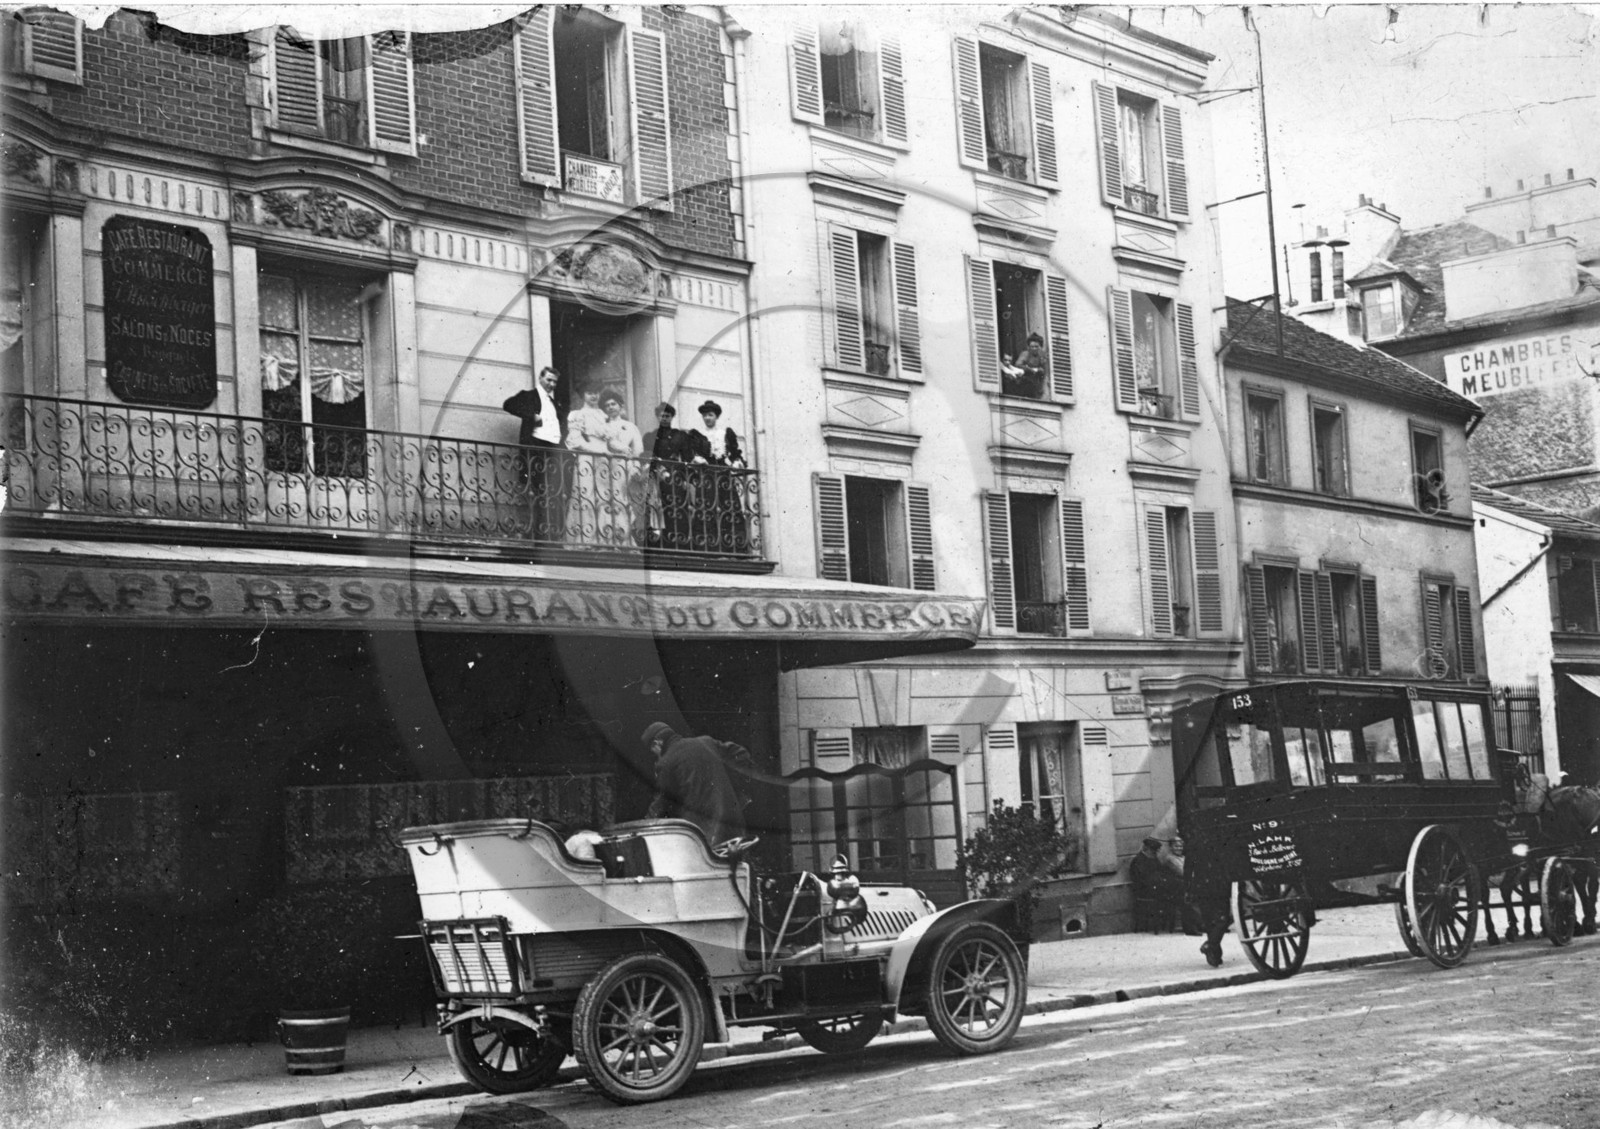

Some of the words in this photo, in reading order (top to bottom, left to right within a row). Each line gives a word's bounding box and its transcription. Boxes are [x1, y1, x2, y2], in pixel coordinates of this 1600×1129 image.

[136, 225, 209, 265] RESTAURANT
[111, 254, 208, 287] COMMERCE
[111, 314, 163, 341] SALONS
[168, 322, 212, 348] NOCES
[1460, 335, 1572, 373] CHAMBRES
[235, 576, 654, 626] RESTAURANT
[665, 604, 714, 629] DU
[728, 601, 973, 630] COMMERCE
[1232, 694, 1252, 710] 153
[1268, 820, 1279, 829] 9
